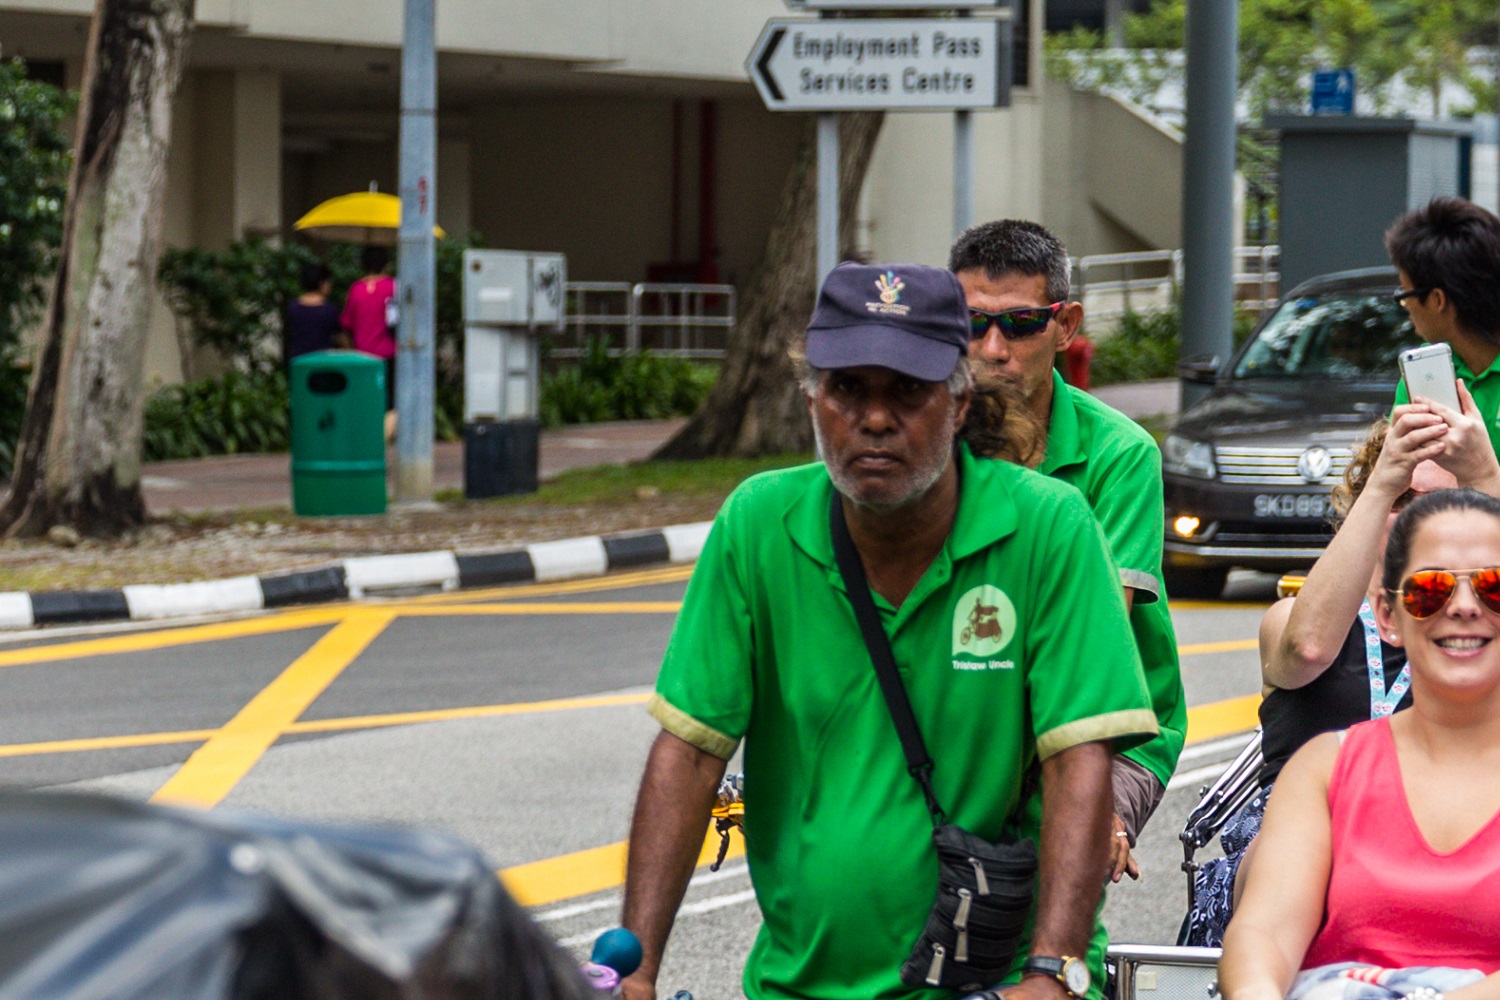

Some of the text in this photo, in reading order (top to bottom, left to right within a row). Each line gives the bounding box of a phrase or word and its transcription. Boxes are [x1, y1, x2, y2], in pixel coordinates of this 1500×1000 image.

[793, 32, 983, 62] Employment Pass
[800, 66, 975, 94] Services Centre
[952, 659, 1015, 671] Trishaw Uncle
